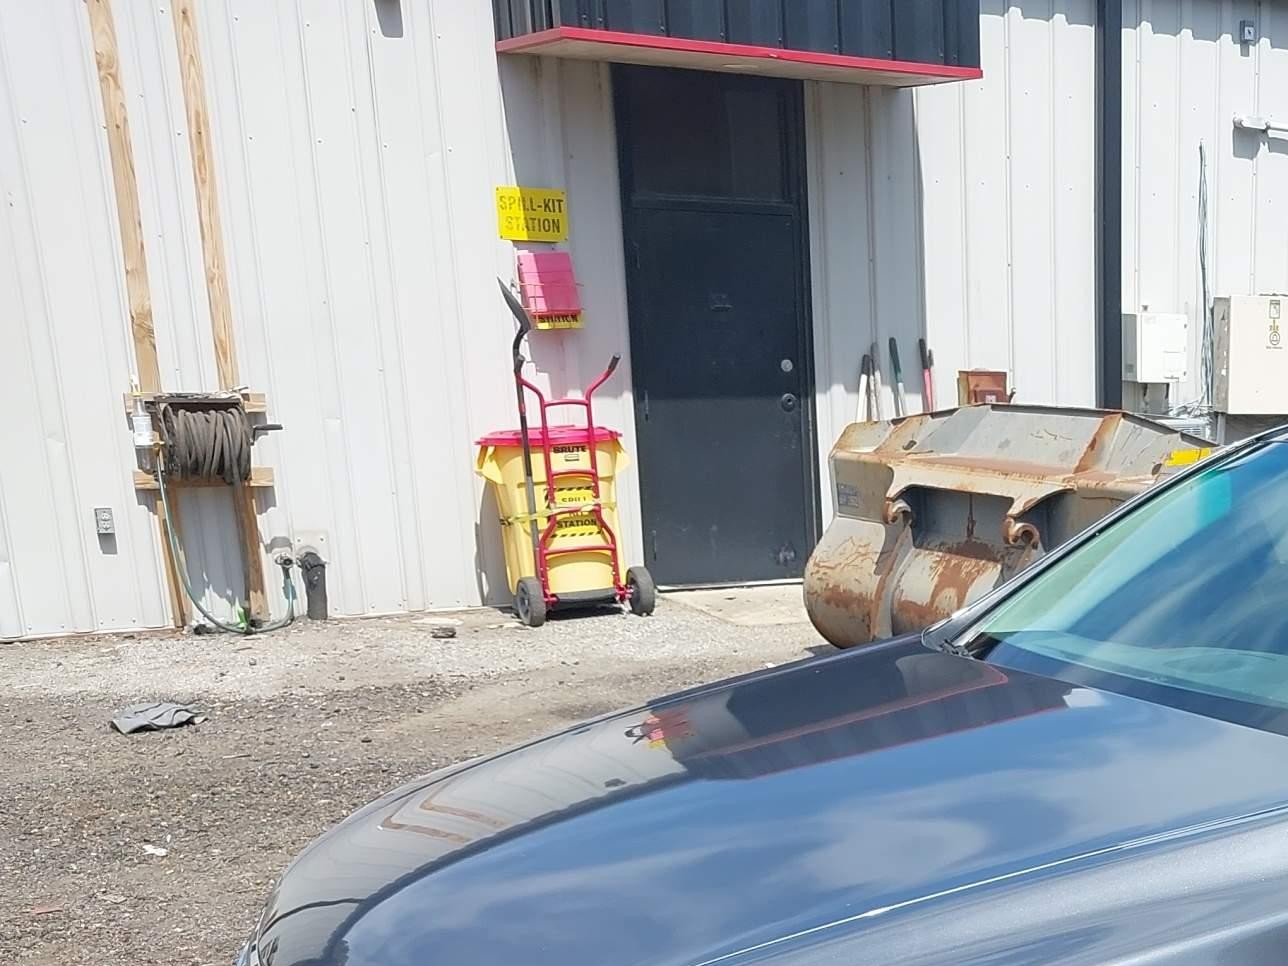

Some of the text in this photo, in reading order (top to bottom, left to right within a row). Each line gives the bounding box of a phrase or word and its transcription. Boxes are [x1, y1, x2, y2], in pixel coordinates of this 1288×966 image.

[499, 195, 564, 213] SPILL-KIT
[504, 215, 561, 233] STATION
[553, 445, 587, 454] BRUTE
[556, 518, 597, 528] STATION
